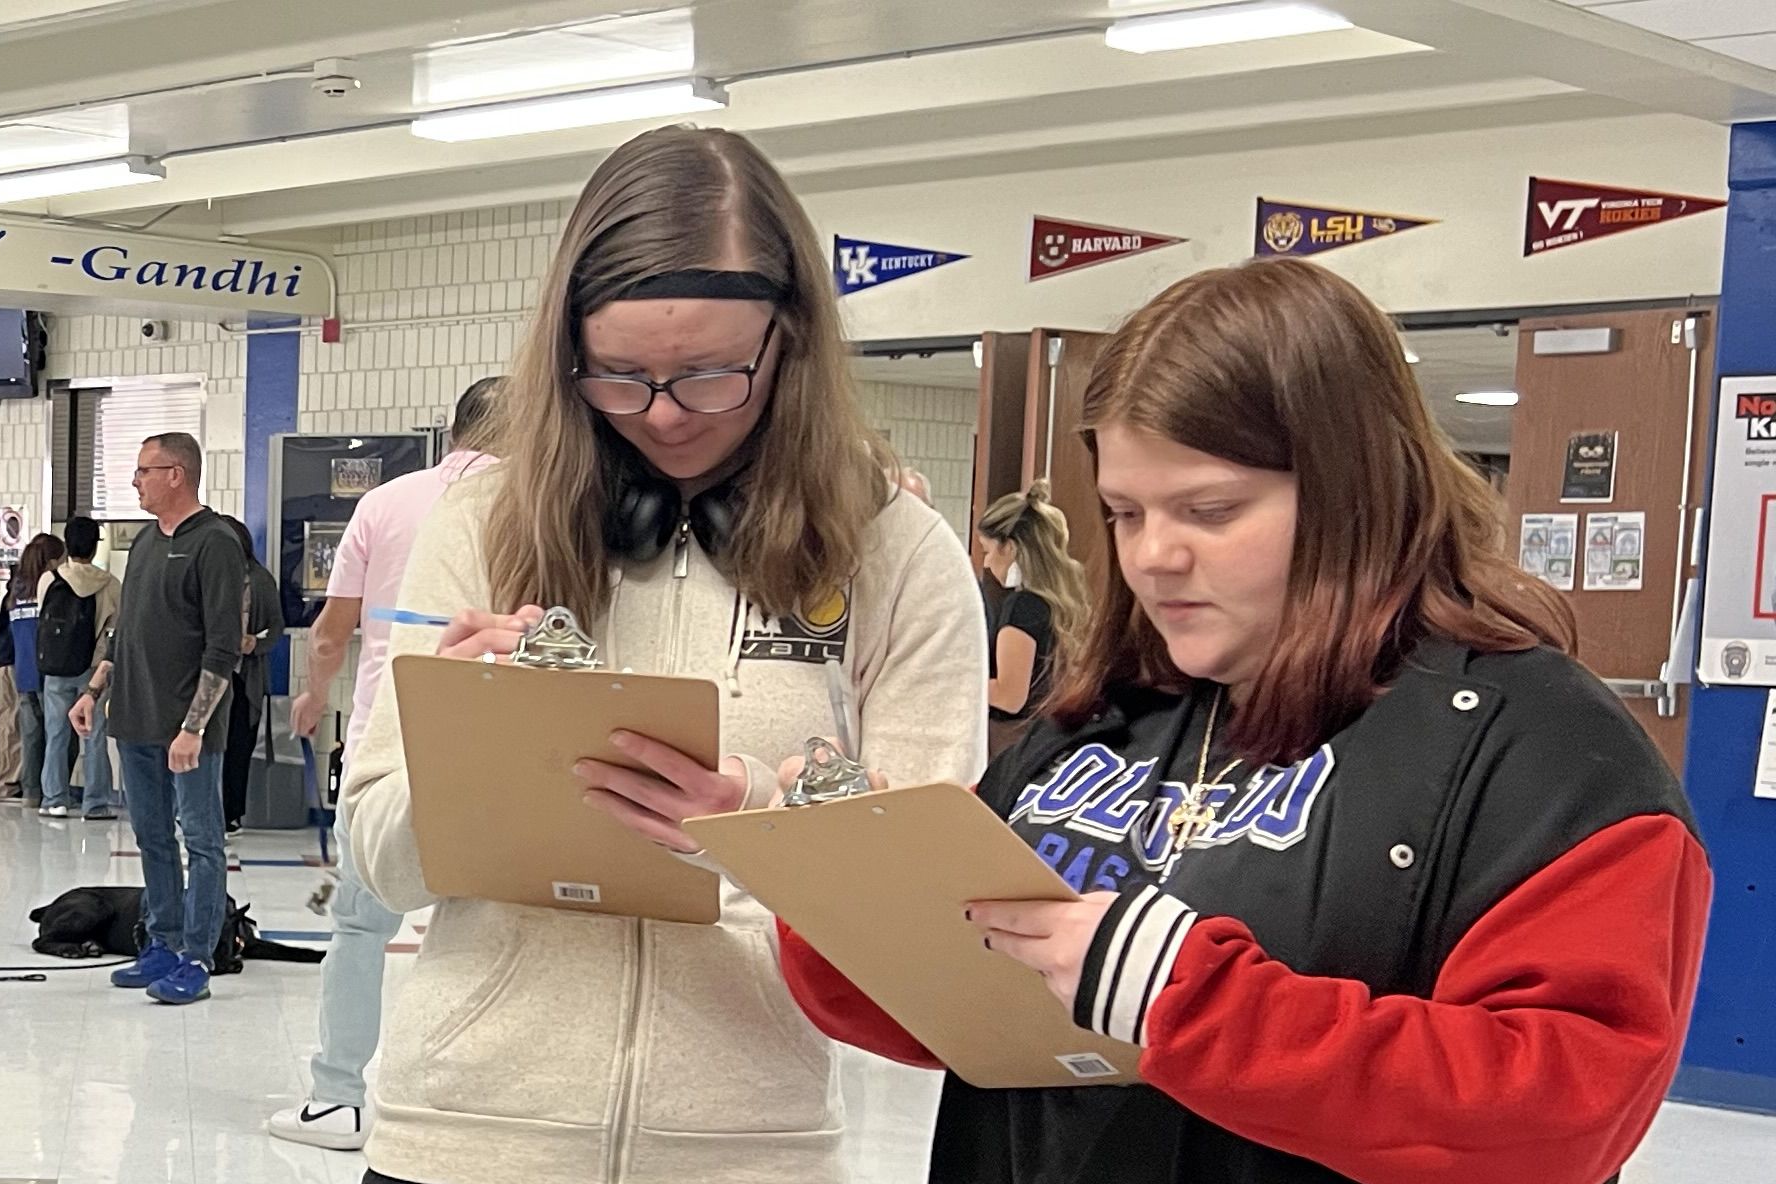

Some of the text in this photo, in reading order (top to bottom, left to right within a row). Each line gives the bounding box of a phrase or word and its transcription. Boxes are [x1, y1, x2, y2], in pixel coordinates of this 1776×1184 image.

[1538, 198, 1600, 230] VT
[1599, 208, 1662, 224] HOKIES
[1310, 215, 1364, 236] LSU
[1071, 236, 1143, 253] HARVARD
[51, 245, 302, 297] -Gandhi
[839, 246, 879, 285] UK
[880, 254, 935, 271] KENTUCKY
